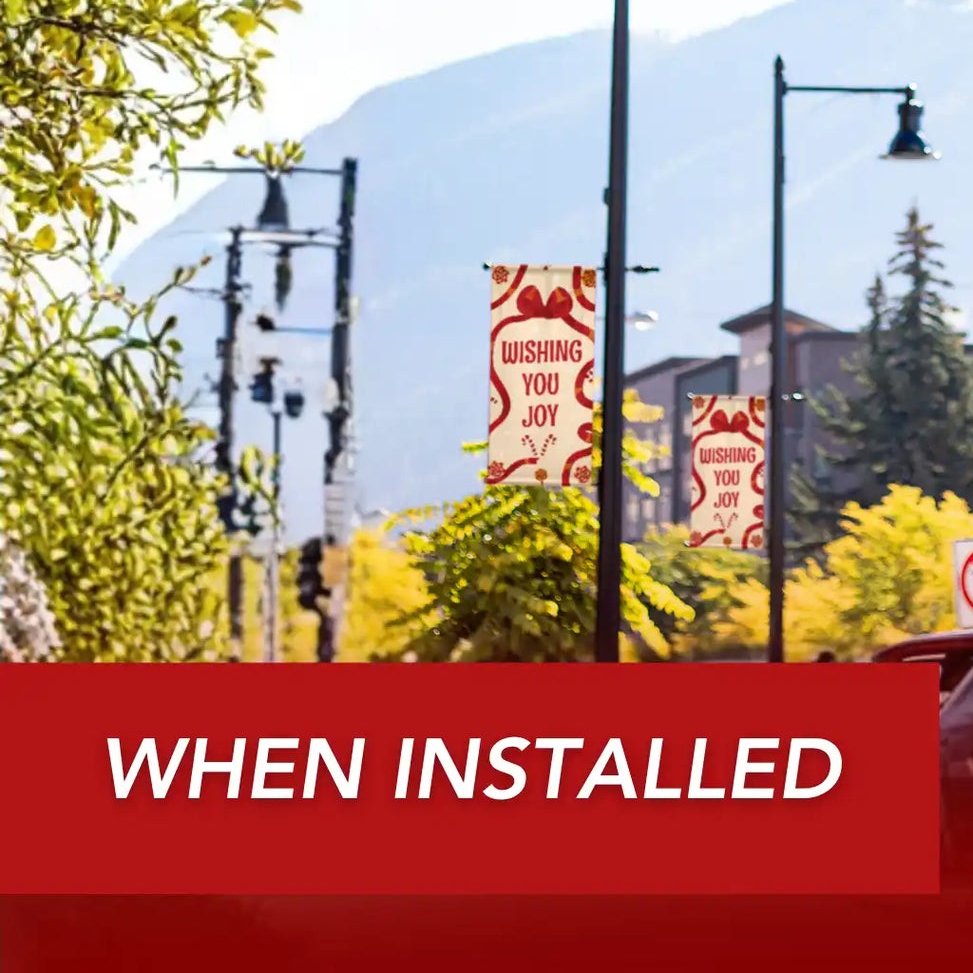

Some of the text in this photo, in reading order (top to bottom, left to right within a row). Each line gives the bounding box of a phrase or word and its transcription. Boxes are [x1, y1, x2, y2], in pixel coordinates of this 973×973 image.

[501, 339, 583, 365] WISHING
[521, 372, 560, 396] YOU
[521, 404, 559, 428] JOY
[699, 447, 757, 464] WISHING
[714, 470, 740, 486] YOU
[714, 492, 740, 508] JOY
